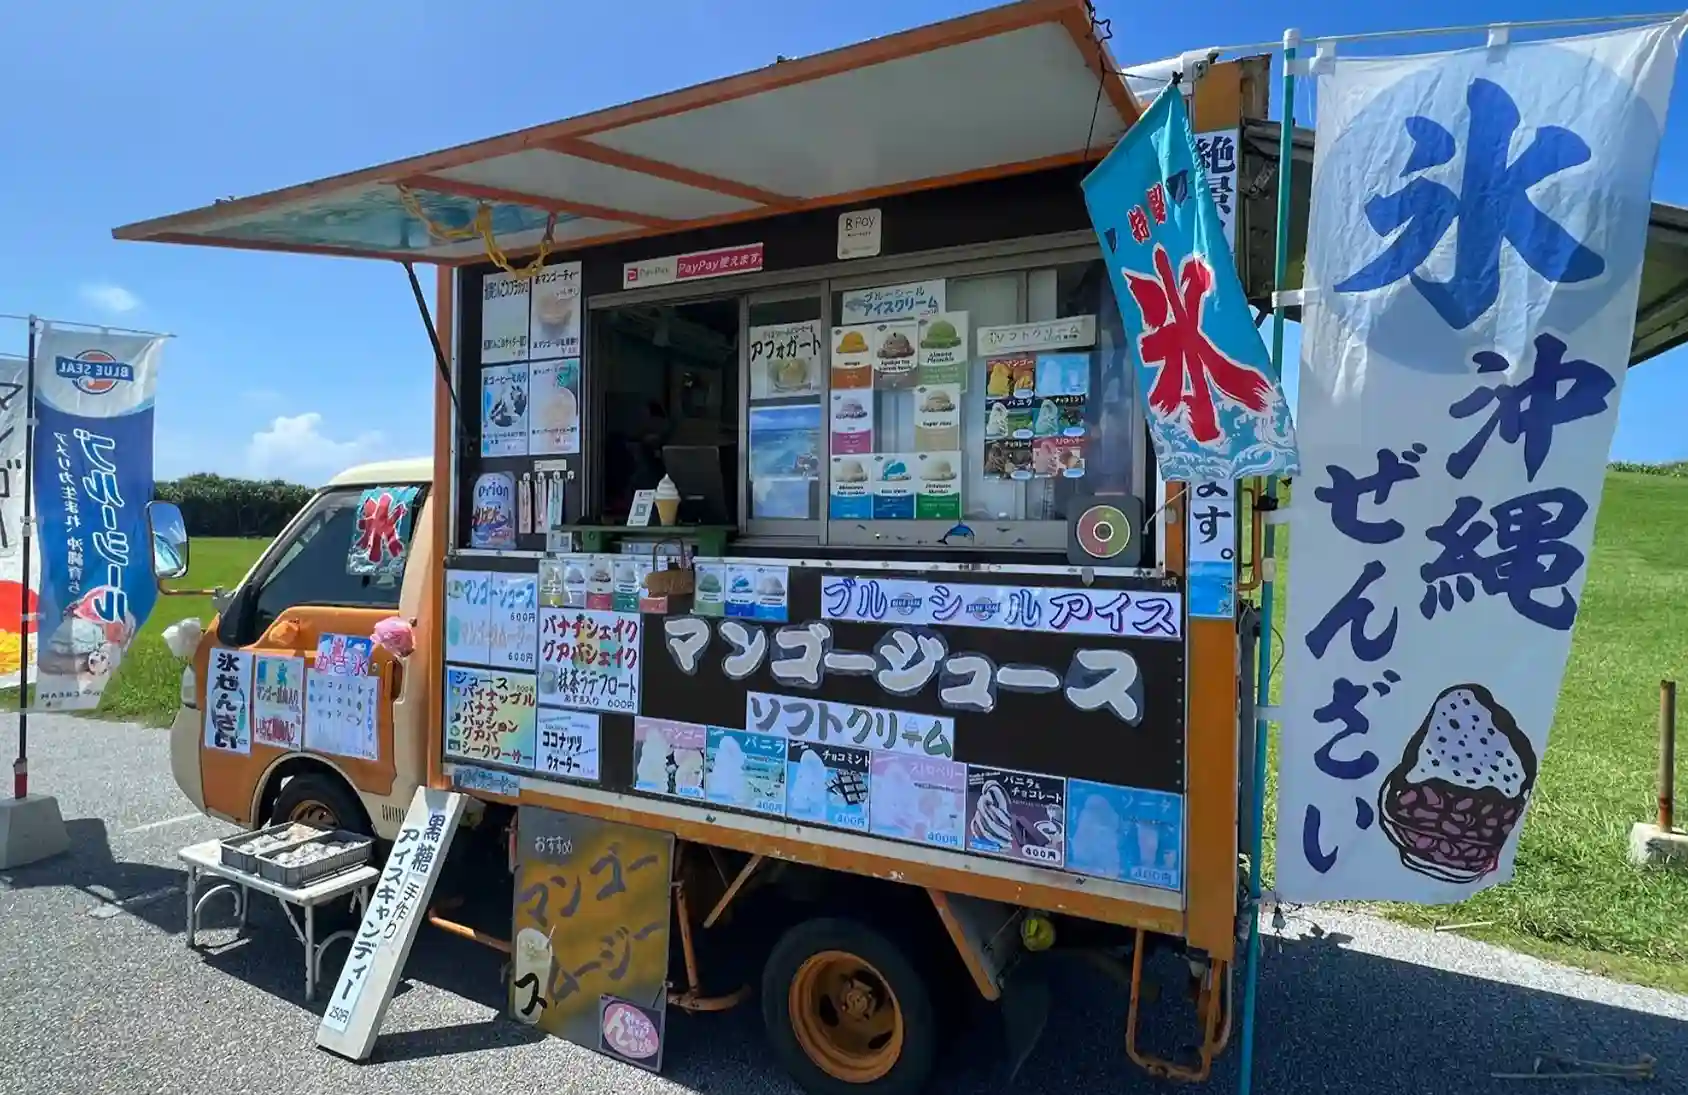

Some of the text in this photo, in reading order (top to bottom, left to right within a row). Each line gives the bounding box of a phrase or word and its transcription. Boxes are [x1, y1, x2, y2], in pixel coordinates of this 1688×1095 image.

[1334, 78, 1605, 331] 氷
[855, 216, 876, 229] Pay
[863, 296, 939, 316] アイスクリーム
[751, 333, 821, 362] アフォガート
[1122, 243, 1272, 445] 氷
[1420, 333, 1617, 632] 沖縄
[355, 492, 407, 563] 氷
[510, 612, 536, 622] 600円
[543, 613, 638, 643] バナナシェイク
[508, 652, 533, 663] 600円
[1302, 440, 1430, 874] ぜんざい
[455, 671, 508, 690] ジュース
[663, 617, 1141, 724] マンゴージュース
[558, 668, 636, 700] 抹茶ラテフロート
[462, 687, 535, 707] パイナップル
[608, 699, 635, 711] 600円
[463, 700, 498, 716] バナナ
[462, 714, 518, 733] パッション
[750, 696, 953, 757] ソフトクリーム
[462, 741, 533, 764] シークワーサー
[744, 736, 785, 753] バニラ
[822, 750, 870, 767] チョコミント
[910, 764, 965, 778] ストロベリー
[1011, 788, 1062, 803] チョコレート
[411, 814, 445, 874] 黒糖
[927, 831, 958, 846] 400円
[1025, 846, 1056, 860] 400円
[519, 842, 659, 927] マンゴー
[342, 828, 420, 1000] アイスキャンディー
[384, 882, 420, 940] 手作り
[328, 1005, 350, 1024] 250円
